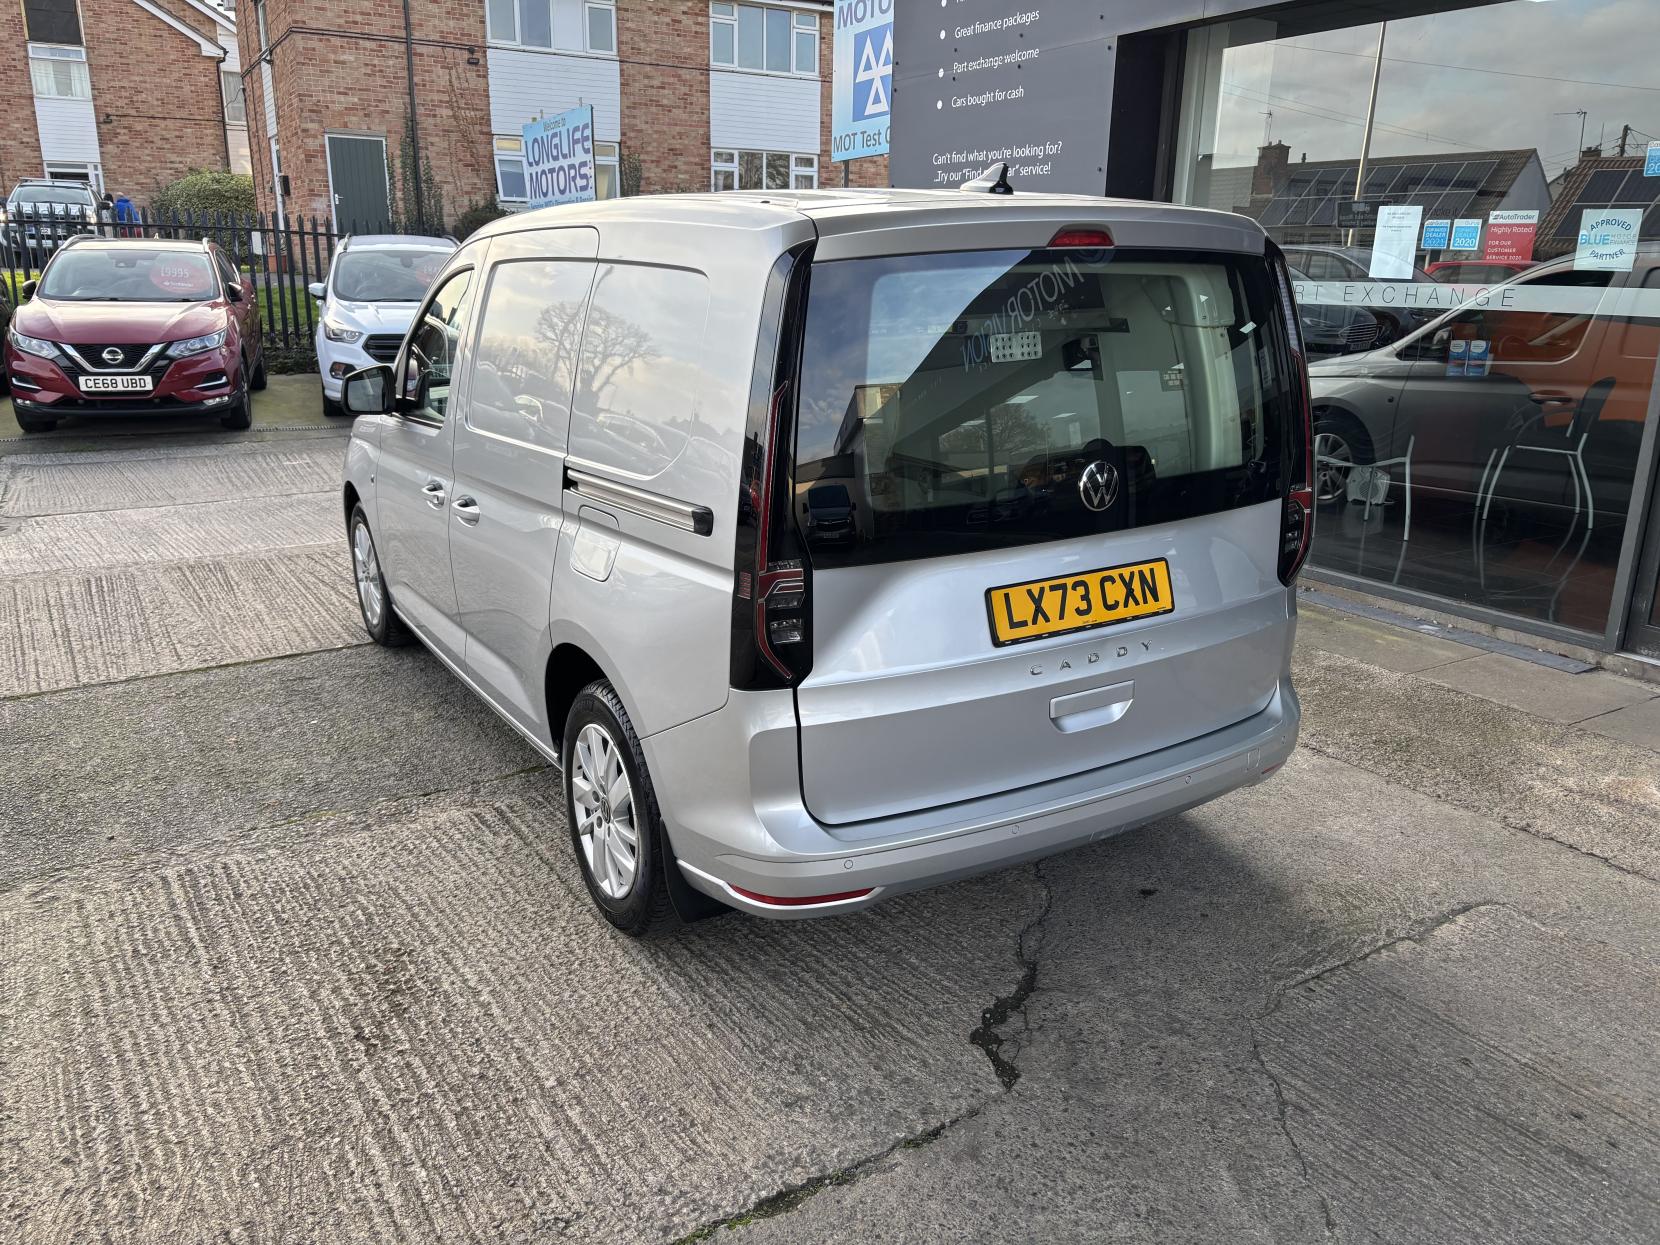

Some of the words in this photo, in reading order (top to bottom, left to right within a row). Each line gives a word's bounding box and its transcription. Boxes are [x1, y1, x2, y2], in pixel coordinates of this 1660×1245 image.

[954, 24, 974, 39] Great
[975, 19, 1002, 34] finance
[1003, 10, 1040, 30] packages
[953, 61, 967, 74] Part
[968, 55, 1003, 69] exchange
[1004, 48, 1040, 63] welcome
[951, 96, 967, 108] Cars
[967, 91, 994, 106] bought
[995, 89, 1006, 102] for
[1007, 86, 1024, 99] cash
[525, 122, 591, 167] LONGLIFE
[833, 132, 857, 154] MOT
[860, 128, 882, 149] Test
[932, 152, 950, 165] Can't
[951, 150, 966, 163] find
[967, 149, 987, 162] what
[987, 147, 1012, 163] you're
[1012, 144, 1044, 158] looking
[1045, 141, 1063, 155] for?
[529, 161, 590, 200] MOTORS
[949, 172, 962, 181] our
[1019, 162, 1051, 176] service!
[1490, 226, 1512, 234] Highly
[1590, 218, 1632, 231] APPROVED
[1425, 238, 1444, 246] 2021
[1455, 238, 1475, 247] 2020
[1579, 234, 1610, 246] BLUE
[1590, 248, 1625, 261] PARTNER
[1343, 285, 1516, 307] EXCHANGE
[84, 378, 118, 389] CE68
[121, 377, 147, 389] UBD
[1003, 579, 1093, 629] LX73
[1099, 567, 1160, 612] CXN
[1029, 639, 1152, 676] CADDY
